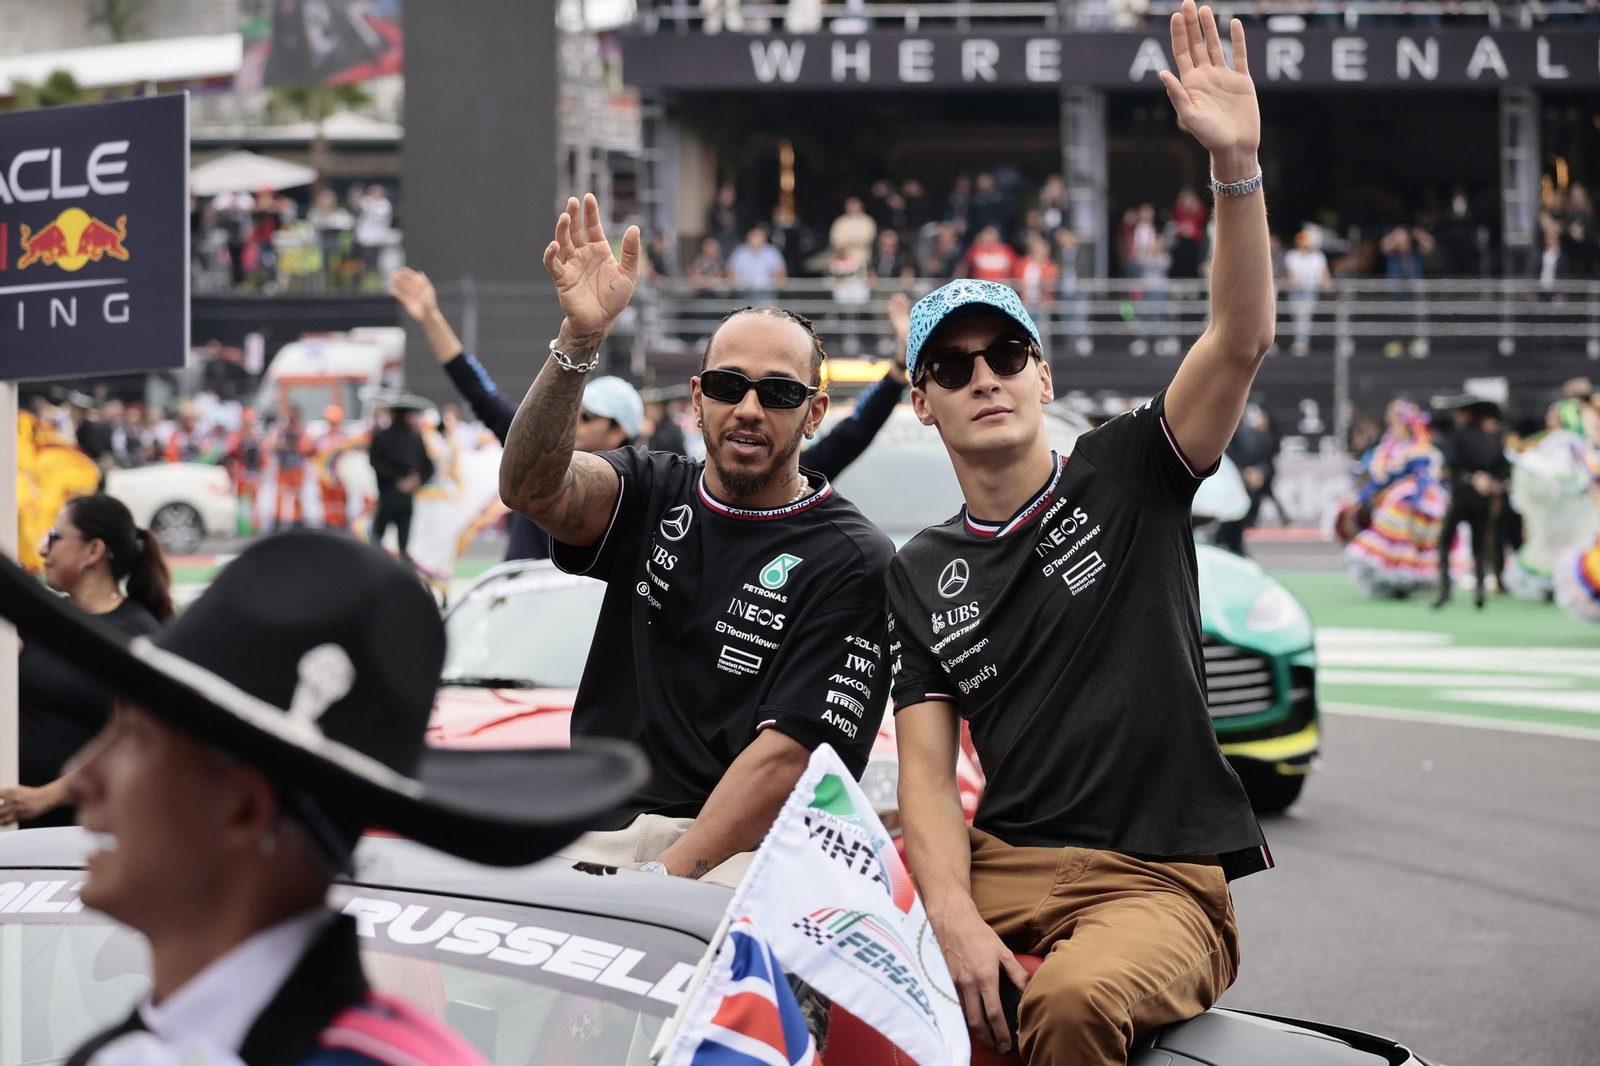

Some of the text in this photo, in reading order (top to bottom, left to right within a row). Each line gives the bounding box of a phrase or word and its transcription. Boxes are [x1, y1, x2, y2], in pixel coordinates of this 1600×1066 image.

[750, 35, 1600, 83] WHERE ARENAL
[725, 494, 824, 520] TOMMY HILFIGER
[1020, 489, 1052, 521] TOMMY
[1034, 506, 1089, 559] INEOS
[1052, 524, 1102, 569] TeamViewer
[1069, 562, 1107, 591] Hewlett Packard
[1071, 577, 1096, 596] Enterprise
[742, 582, 788, 604] PETRONAS
[726, 597, 786, 630] INEOS
[946, 600, 980, 626] UBS
[726, 624, 780, 651] TeamViewer
[933, 618, 981, 651] CROWDSTRIKE
[718, 658, 739, 670] Hewlett
[844, 653, 876, 678] IWC
[948, 637, 990, 668] Snapdragon
[716, 663, 742, 676] Enterprise
[825, 690, 865, 719] PIRELLI
[821, 709, 853, 735] AMD
[341, 896, 698, 1007] RUSSELL
